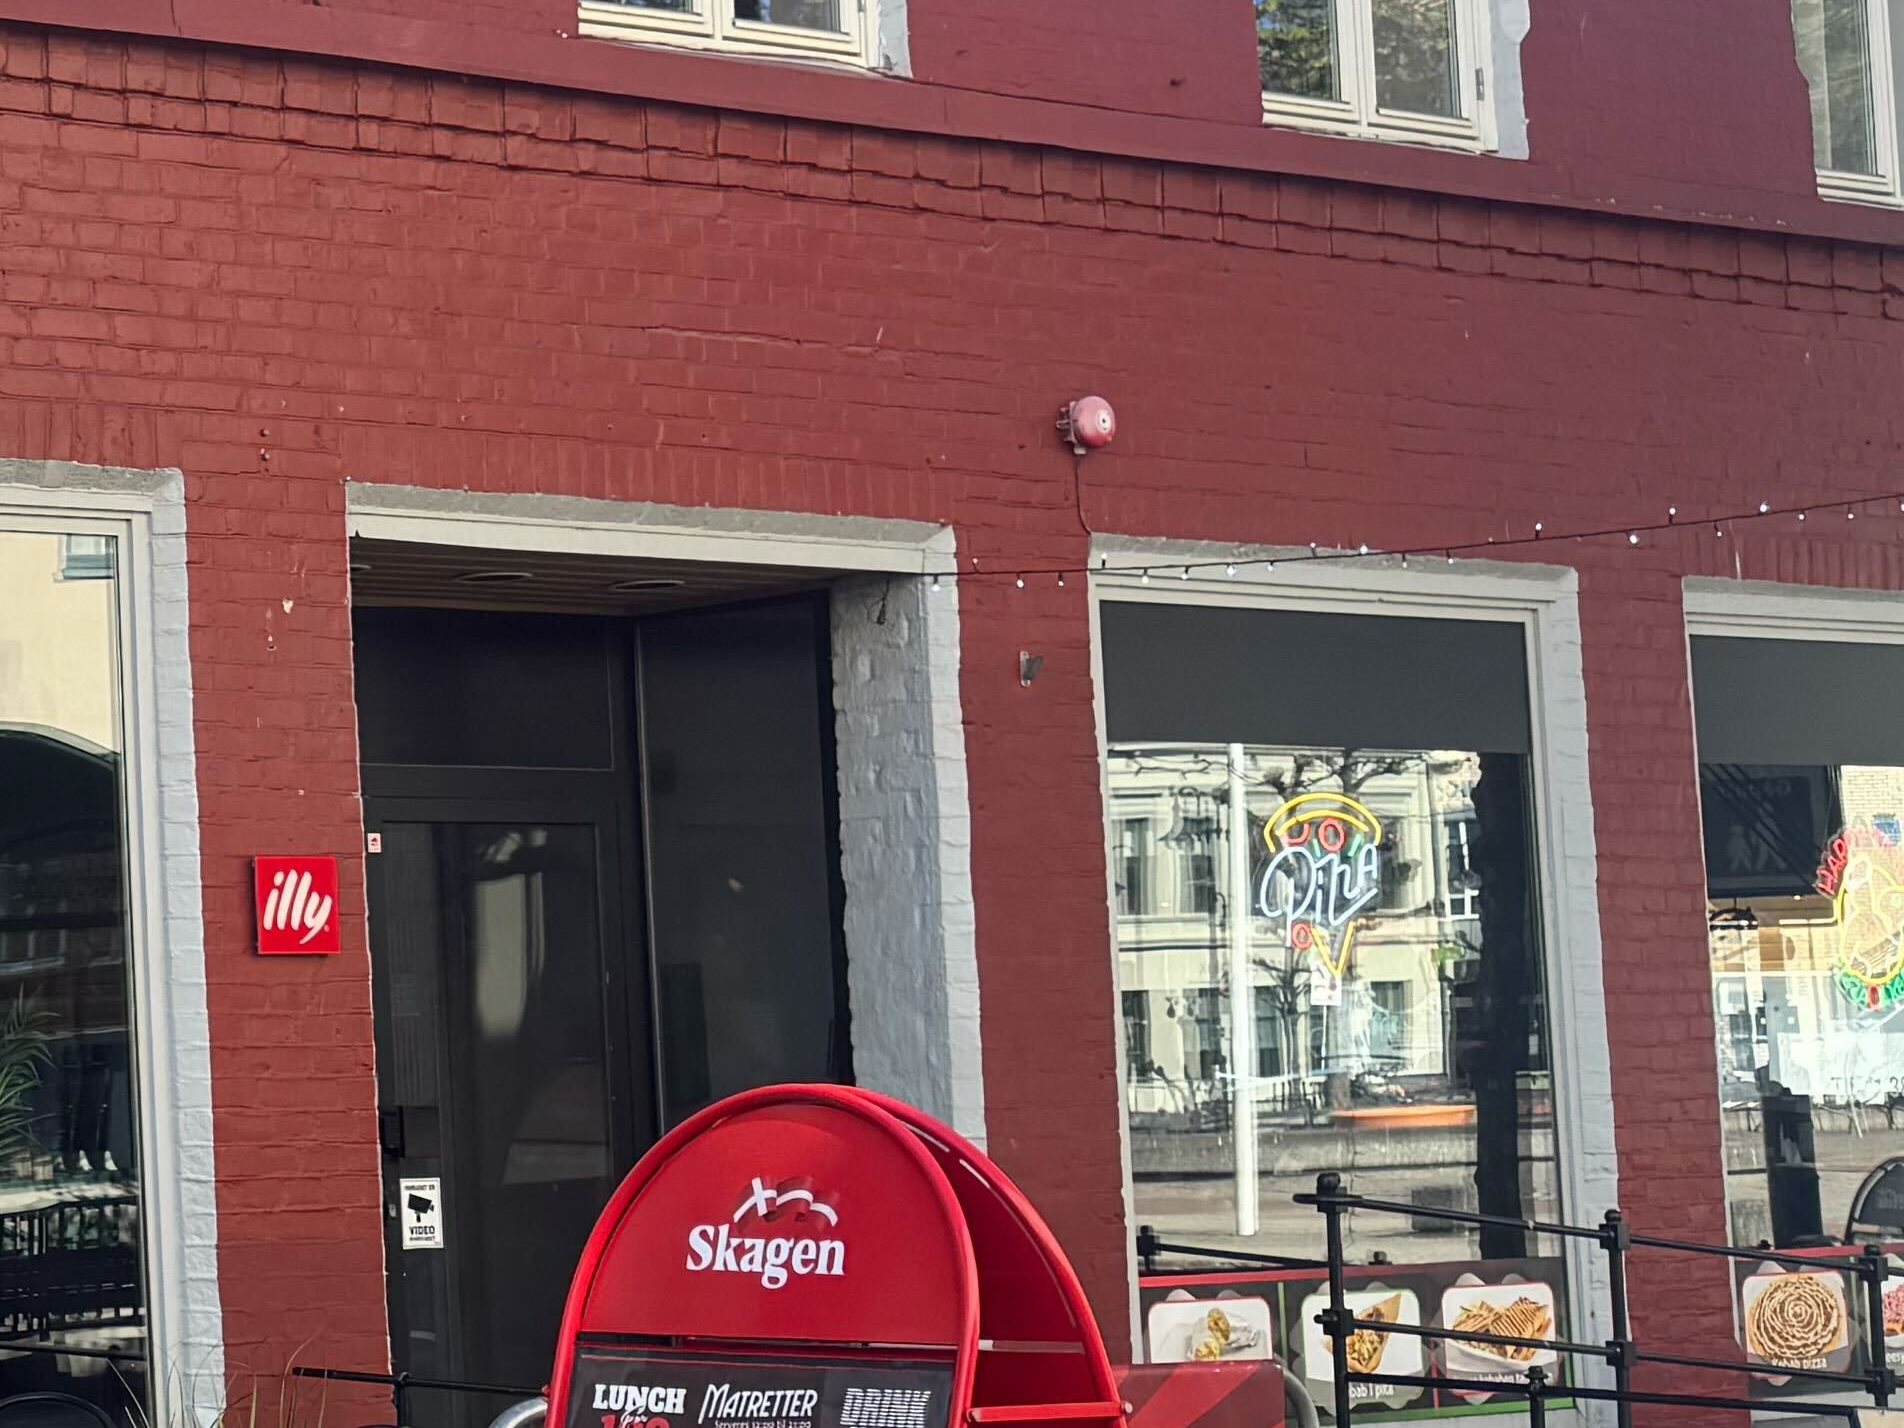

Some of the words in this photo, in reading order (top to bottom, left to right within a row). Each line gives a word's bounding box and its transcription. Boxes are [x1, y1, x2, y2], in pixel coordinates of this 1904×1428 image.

[263, 869, 332, 945] illy
[409, 1225, 436, 1235] VIDEO
[686, 1223, 845, 1290] Skagen
[592, 1384, 687, 1414] LUNCH
[698, 1383, 818, 1424] MATRETTER
